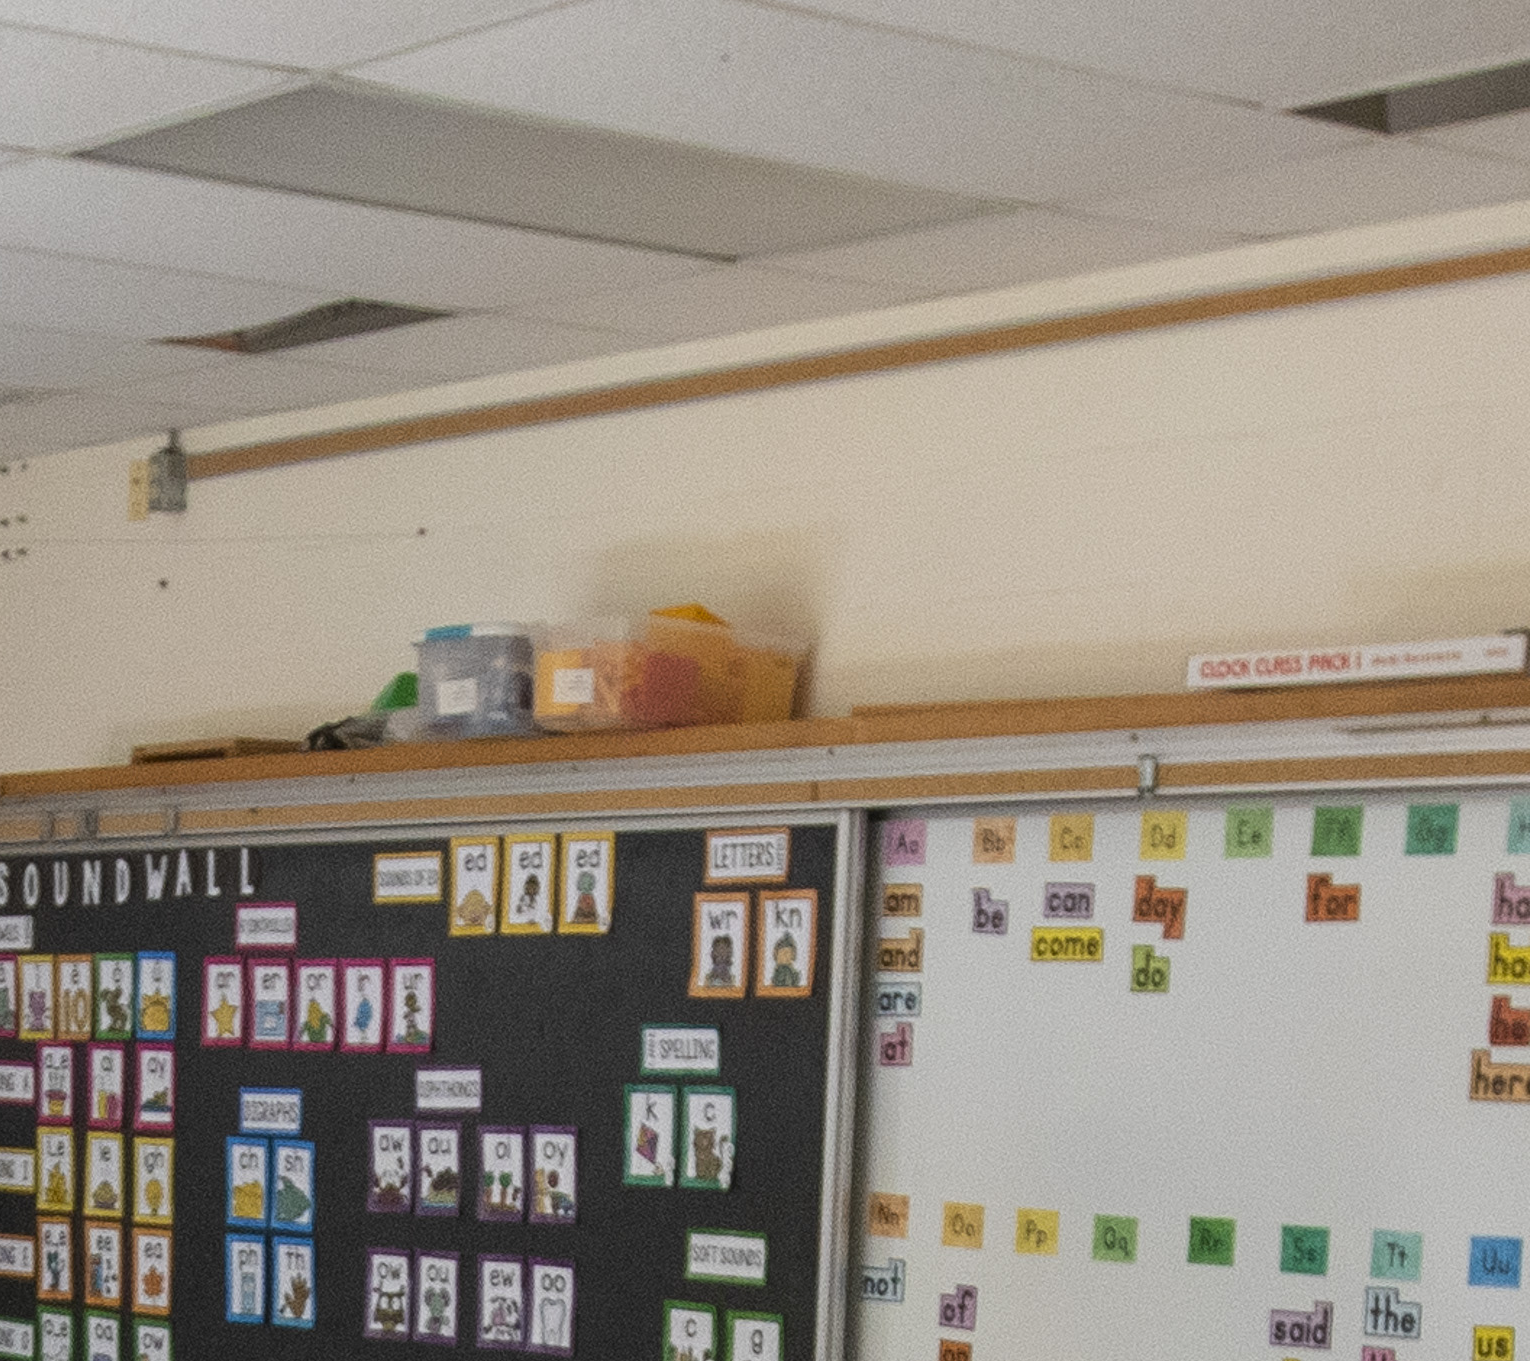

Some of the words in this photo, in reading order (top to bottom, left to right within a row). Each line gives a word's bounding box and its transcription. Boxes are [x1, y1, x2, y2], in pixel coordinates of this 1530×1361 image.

[1150, 825, 1177, 850] Dd
[463, 845, 487, 872] ed
[518, 843, 543, 870] ed
[575, 841, 600, 868] ed
[713, 841, 775, 870] LETTERS
[886, 890, 919, 914] am
[976, 889, 1005, 930] be
[1047, 889, 1091, 914] can
[1136, 880, 1185, 936] day
[1312, 877, 1358, 918] for
[708, 908, 738, 930] wr
[774, 901, 803, 930] kn
[880, 932, 921, 969] and
[1034, 933, 1100, 958] come
[1135, 949, 1166, 990] do
[878, 988, 917, 1013] are
[883, 1028, 909, 1060] at
[542, 1140, 569, 1167] oy
[1024, 1219, 1049, 1248] Pp
[1102, 1225, 1129, 1257] Qq
[1482, 1249, 1512, 1277] Uu
[489, 1268, 516, 1288] ew
[541, 1273, 567, 1293] oo
[862, 1261, 901, 1296] not
[942, 1288, 974, 1324] of
[1369, 1293, 1417, 1334] the
[1273, 1305, 1329, 1346] said
[1476, 1333, 1509, 1360] us
